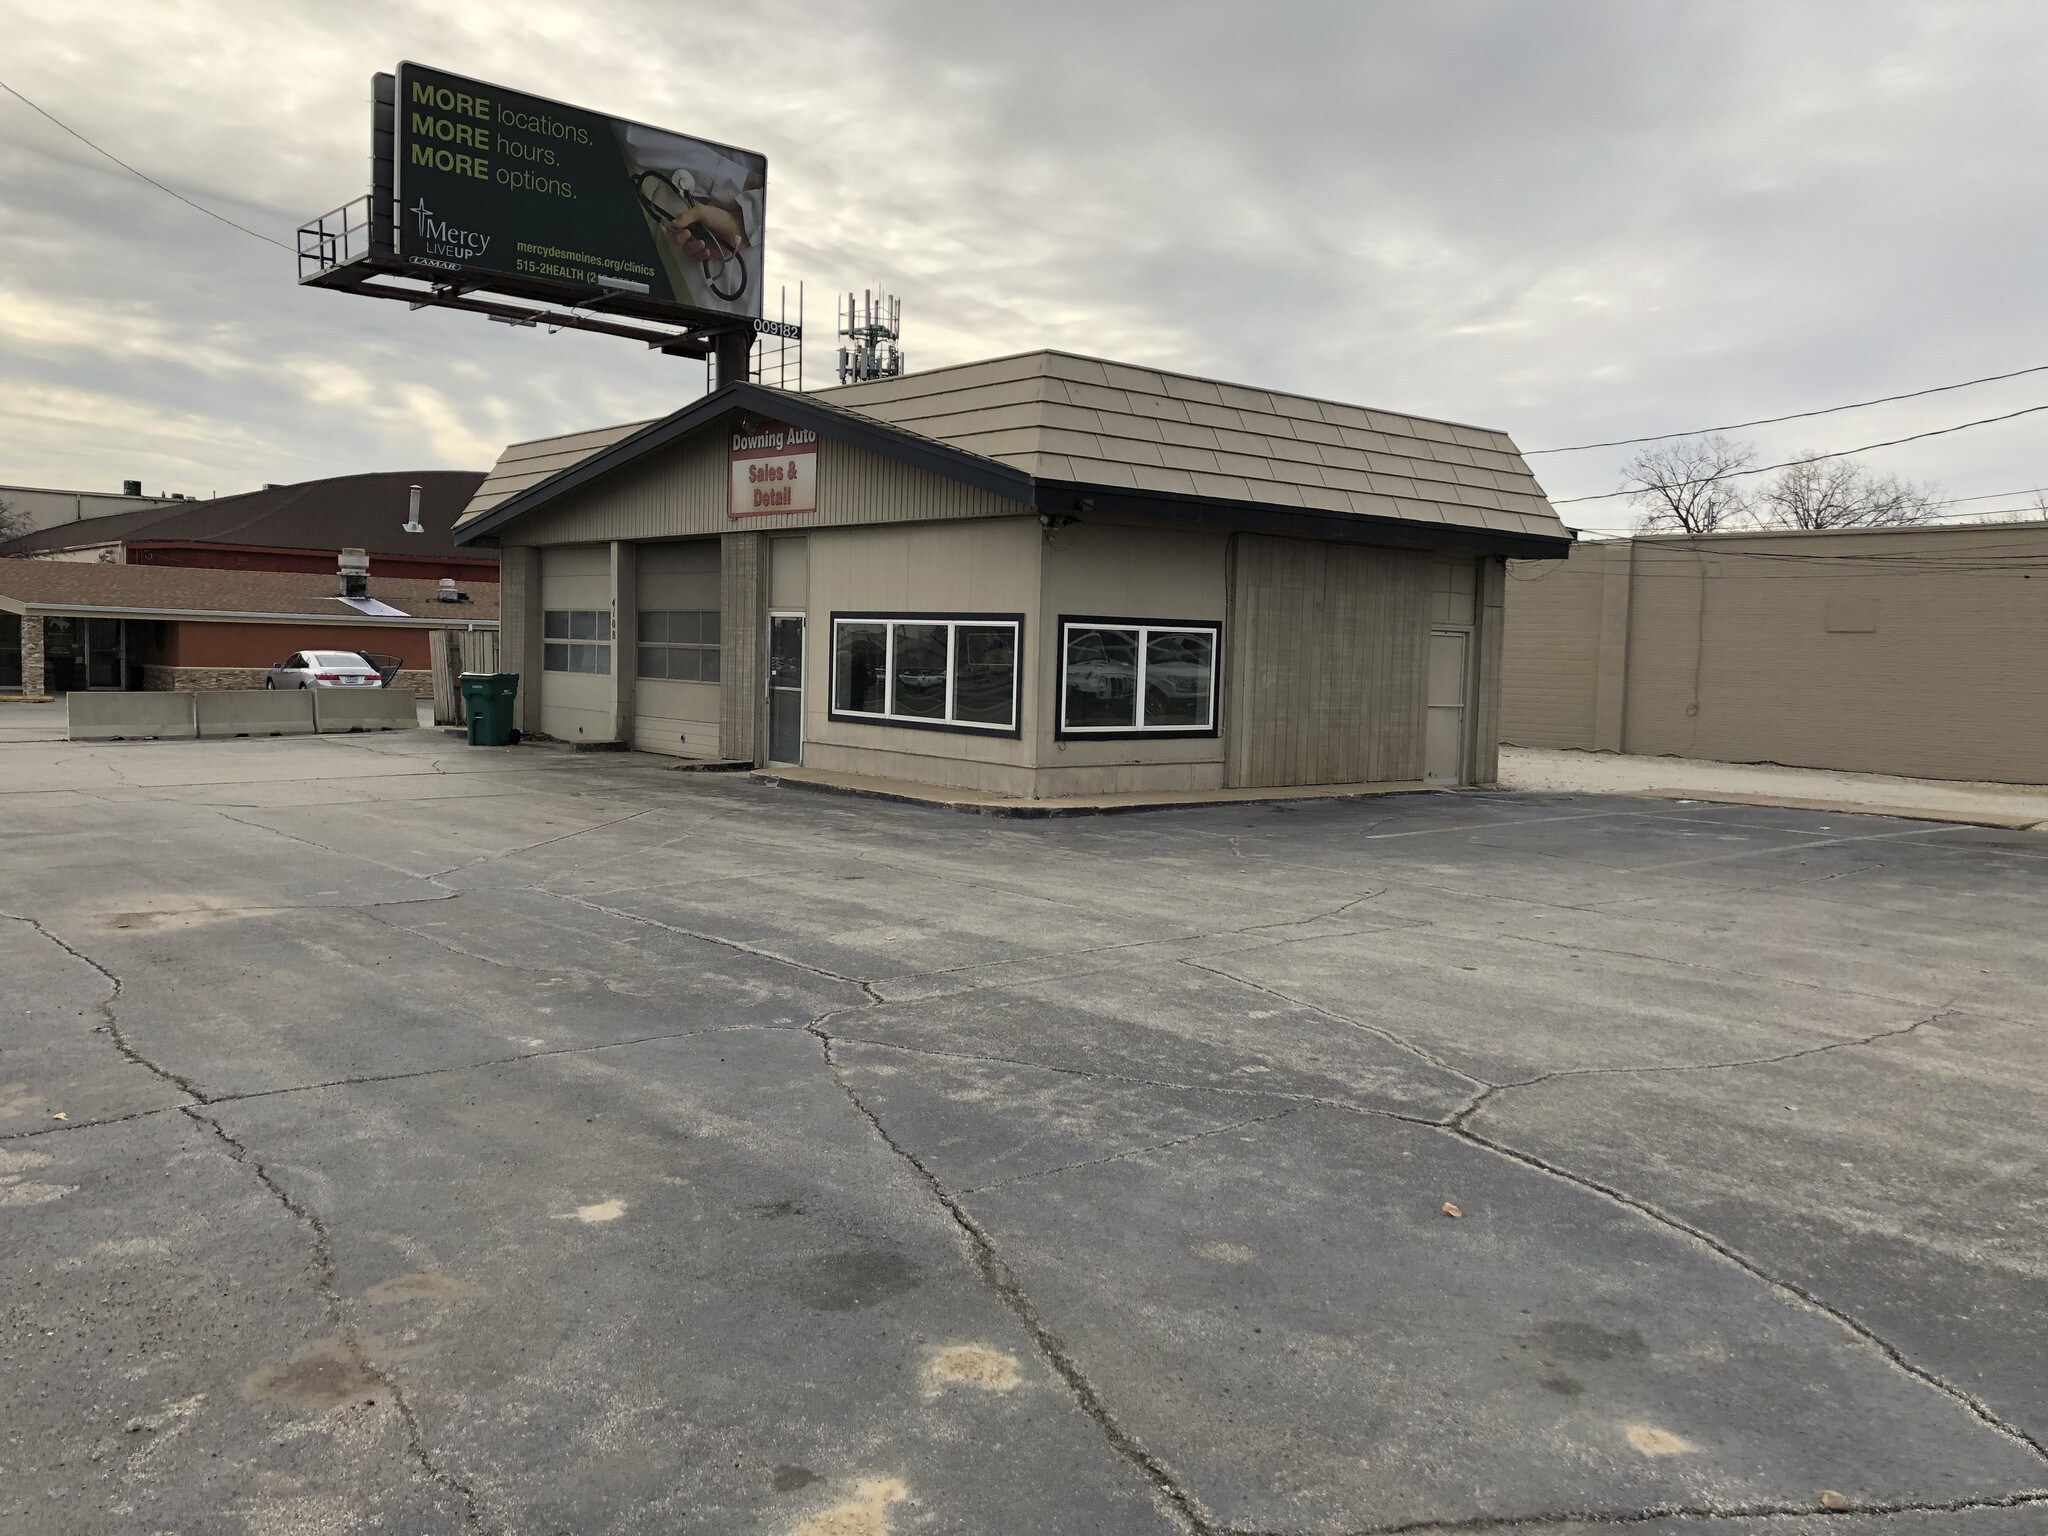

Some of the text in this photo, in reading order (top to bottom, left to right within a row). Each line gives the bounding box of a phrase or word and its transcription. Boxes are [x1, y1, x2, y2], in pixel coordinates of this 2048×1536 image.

[412, 81, 593, 146] MORE locations.
[412, 112, 560, 167] MORE hours.
[411, 143, 577, 199] MORE options.
[426, 218, 491, 256] Mercy
[413, 257, 457, 271] LAMAR
[516, 241, 656, 277] mercydesmoines.org/clinics
[516, 259, 584, 281] 515-2HEALTH
[753, 318, 799, 339] 009182
[732, 427, 817, 451] Downing Auto
[748, 460, 798, 484] Sales &
[753, 486, 792, 507] Detail
